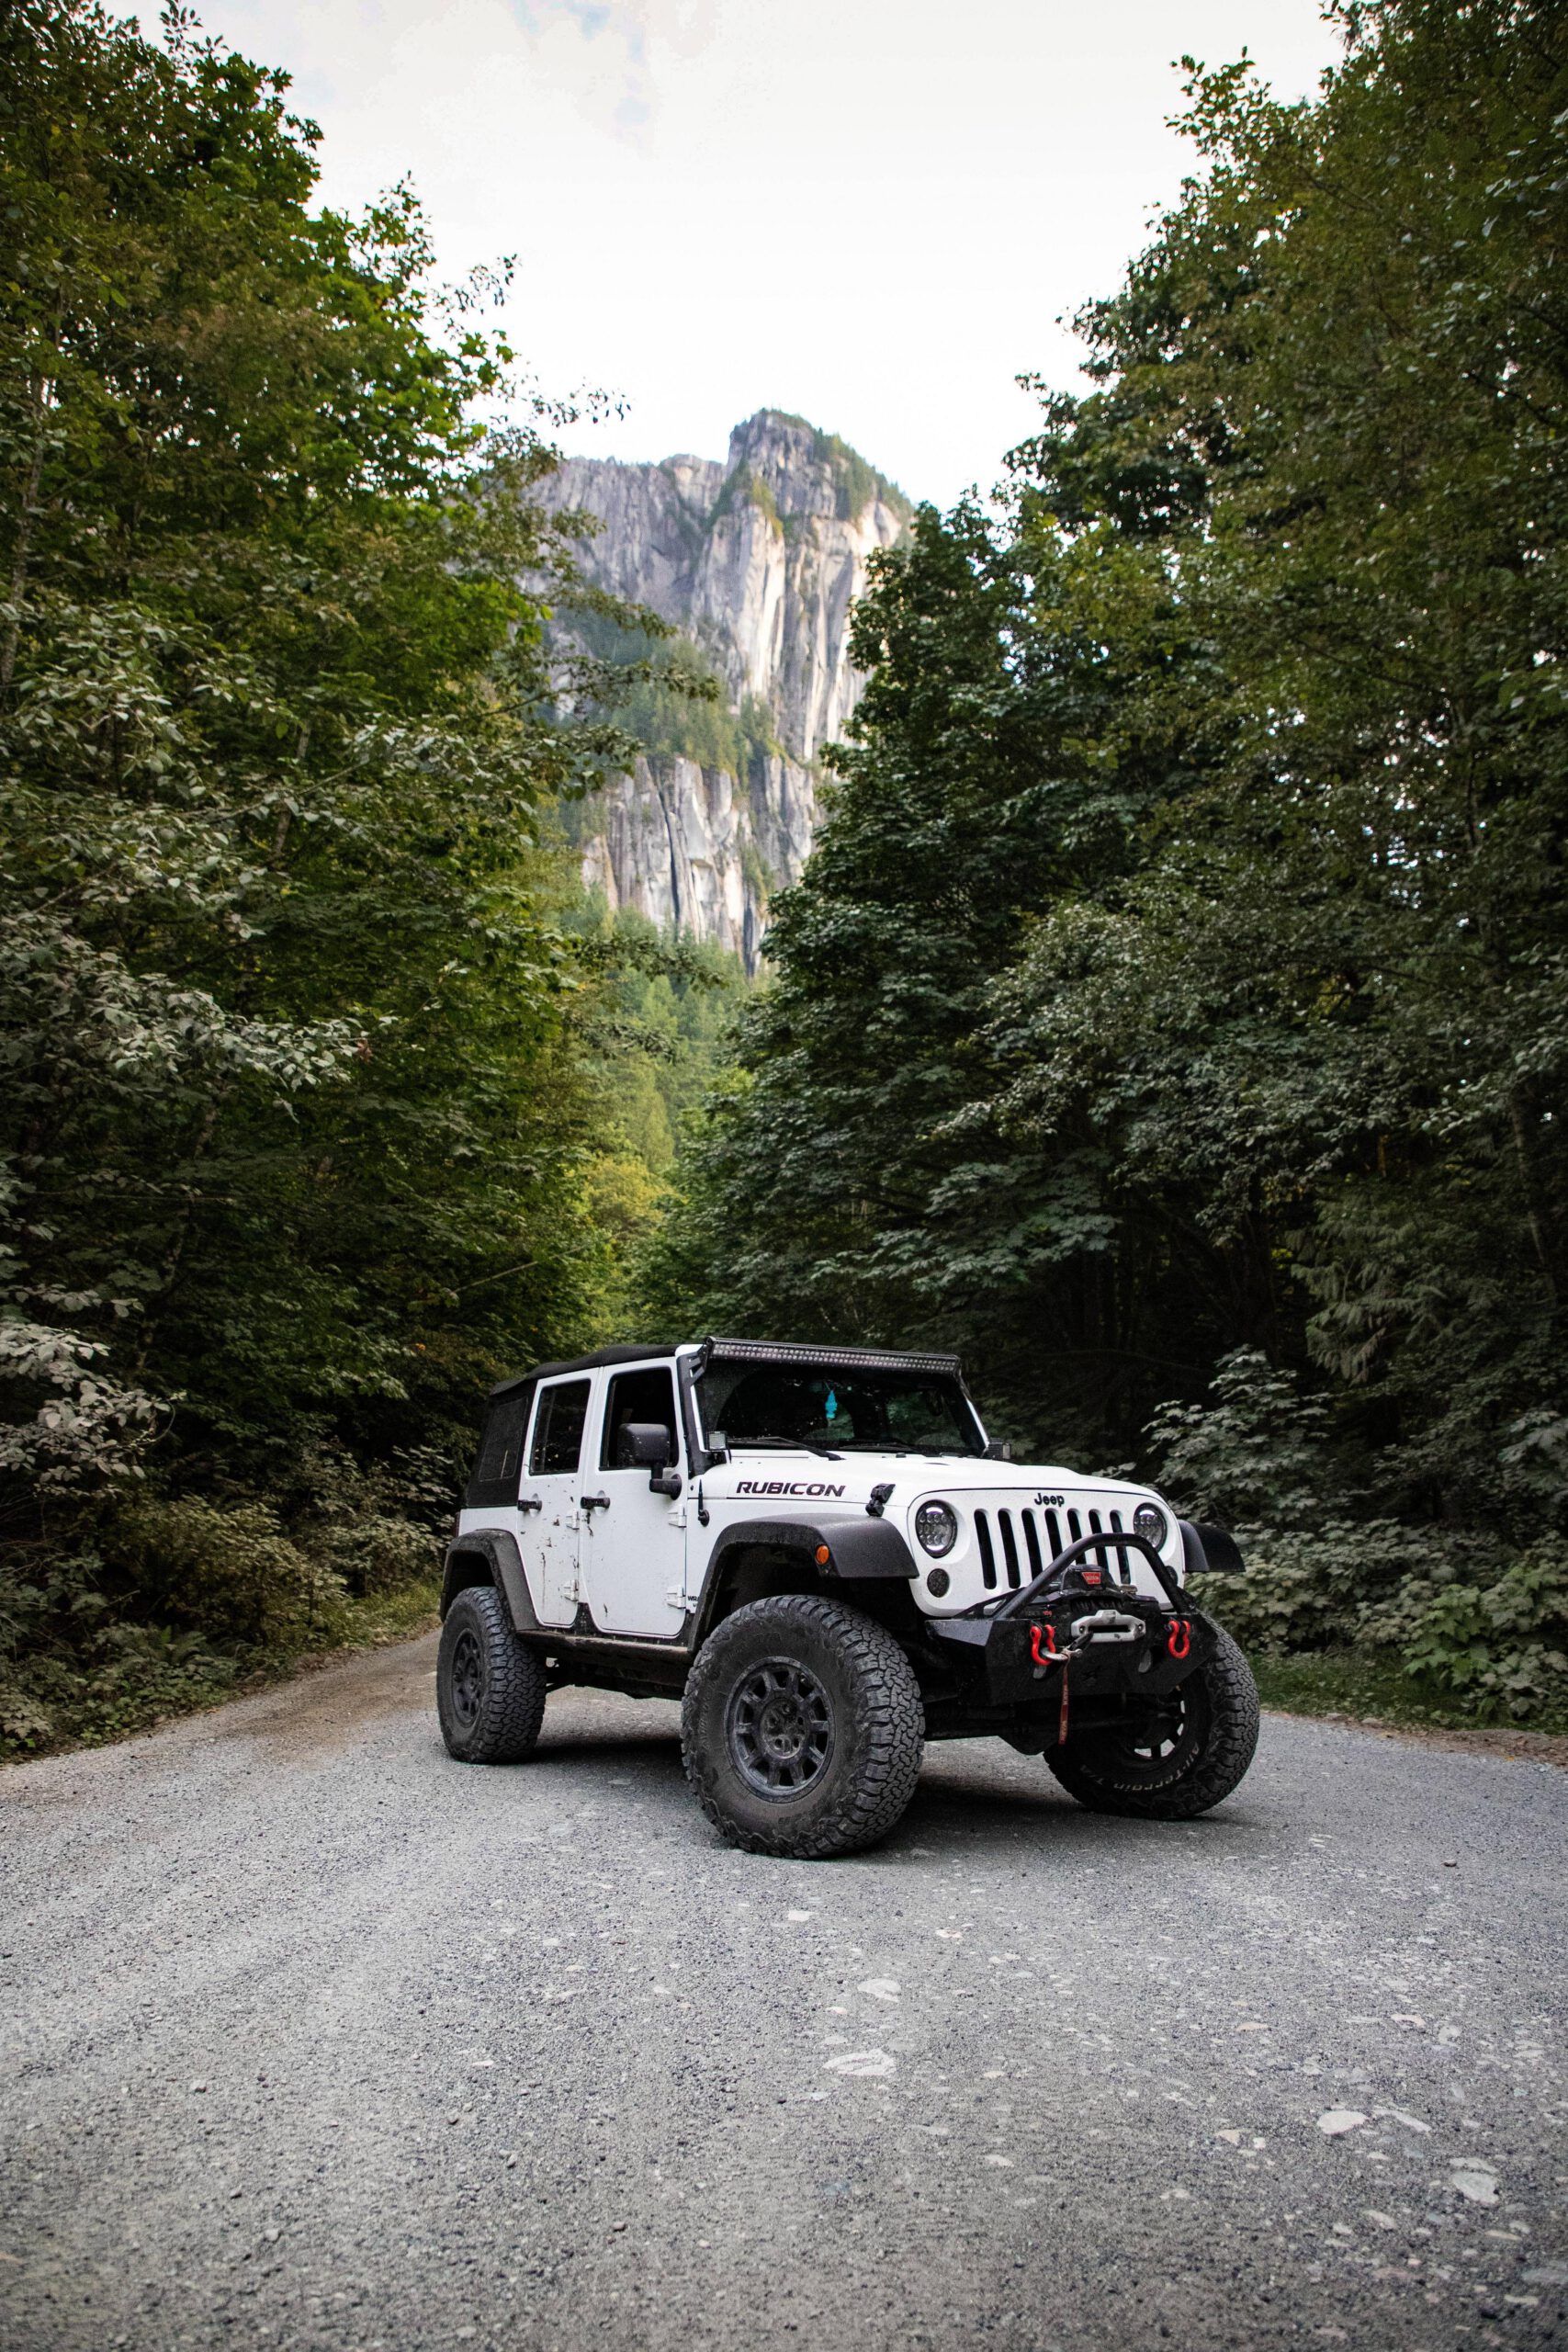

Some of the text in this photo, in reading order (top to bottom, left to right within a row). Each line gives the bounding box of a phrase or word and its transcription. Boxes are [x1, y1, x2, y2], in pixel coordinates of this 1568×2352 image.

[736, 1481, 846, 1498] RUBICON
[1034, 1492, 1065, 1507] Jeep
[1112, 1742, 1200, 1792] All-Terrain
